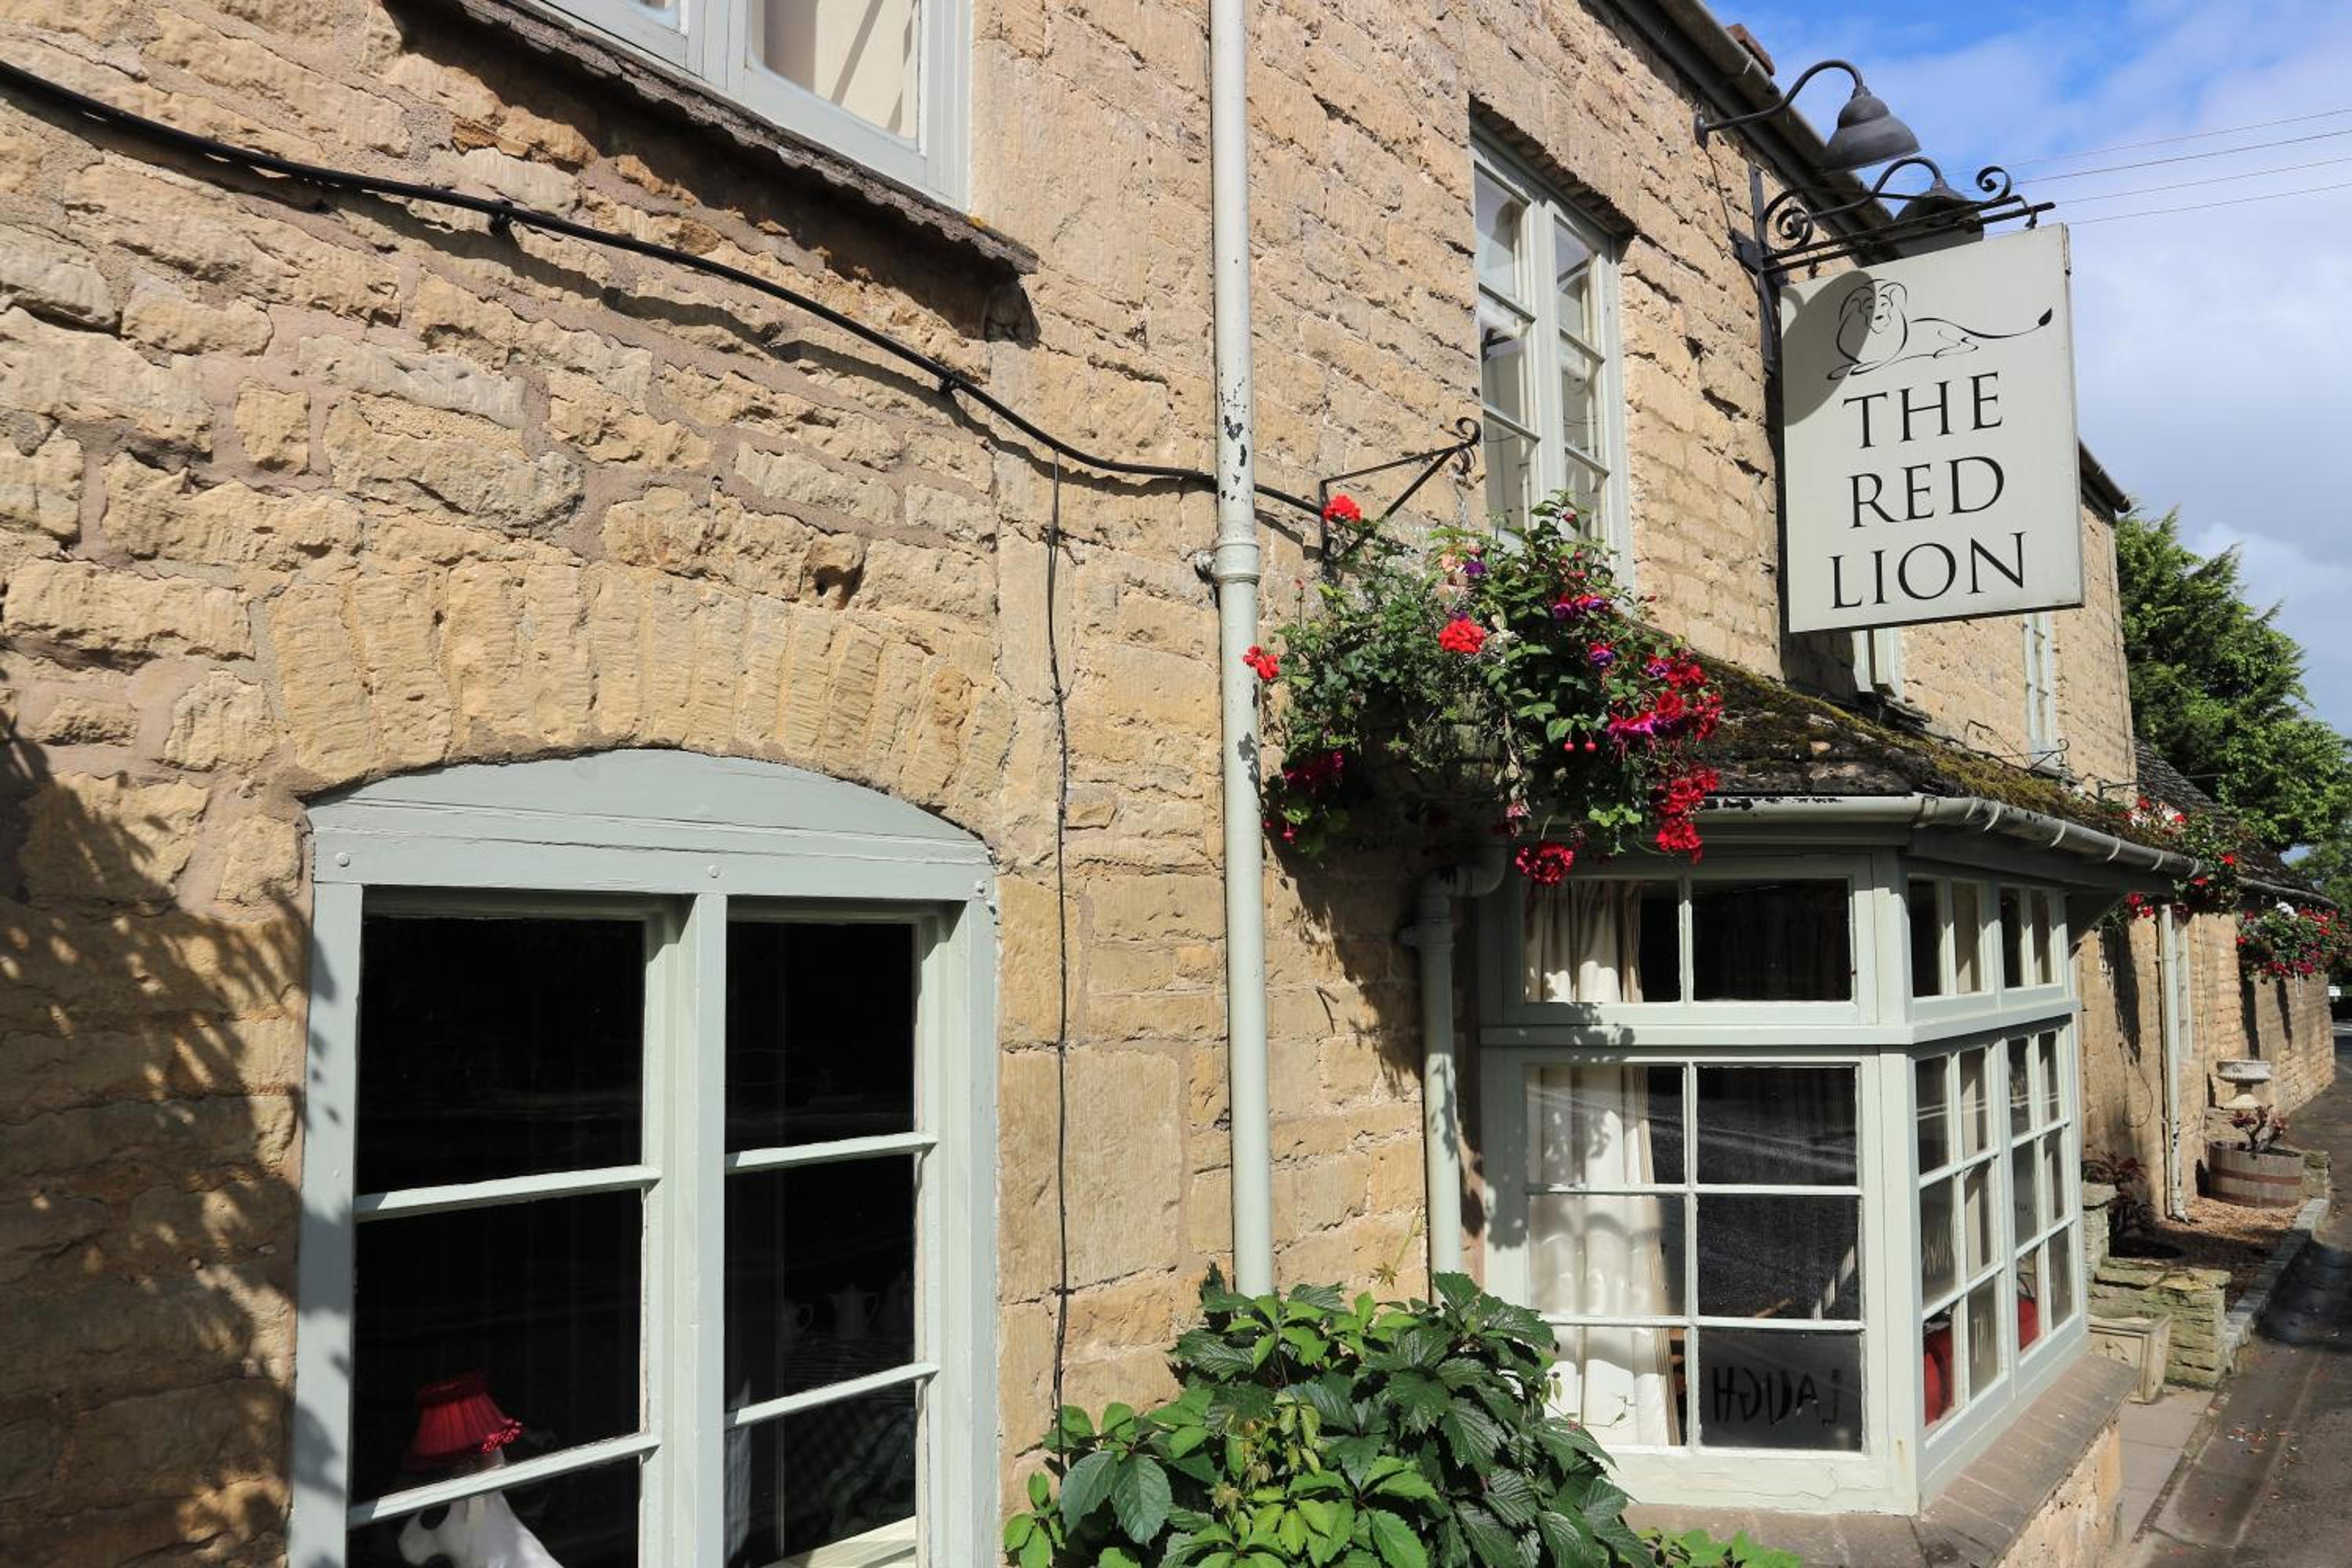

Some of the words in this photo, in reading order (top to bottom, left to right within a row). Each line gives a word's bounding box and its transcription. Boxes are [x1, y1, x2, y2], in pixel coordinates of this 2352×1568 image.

[1842, 372, 2002, 449] THE
[1846, 456, 2005, 528] RED
[1828, 532, 2026, 609] LION
